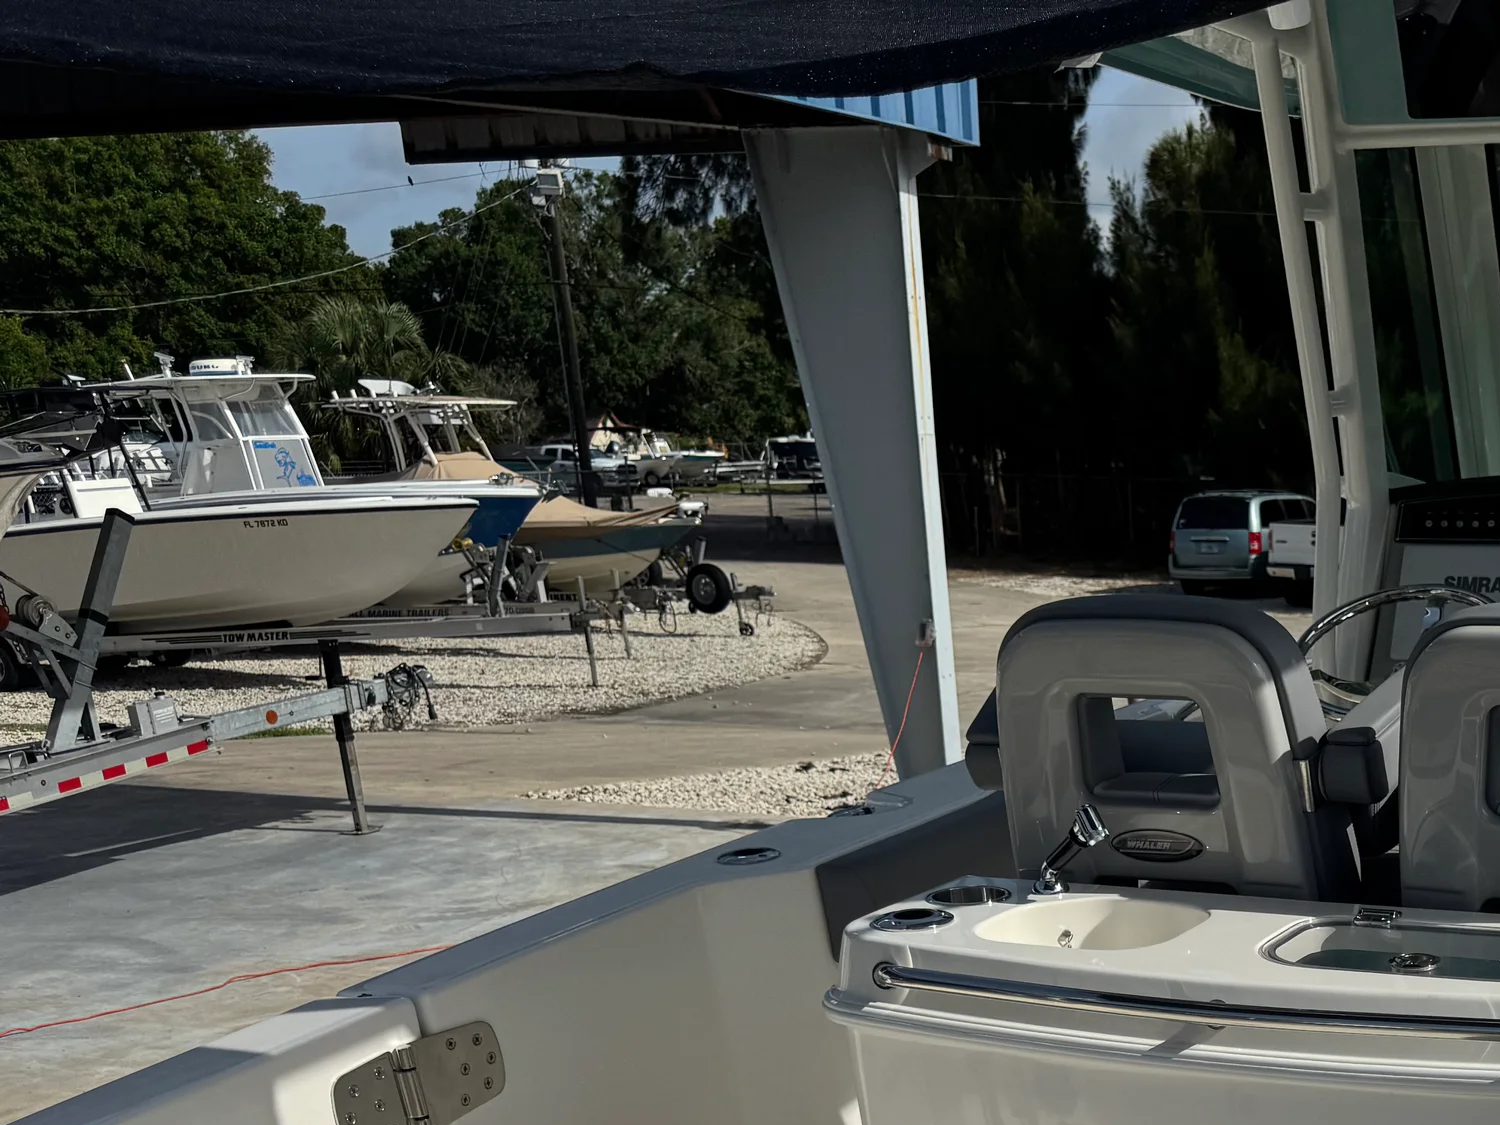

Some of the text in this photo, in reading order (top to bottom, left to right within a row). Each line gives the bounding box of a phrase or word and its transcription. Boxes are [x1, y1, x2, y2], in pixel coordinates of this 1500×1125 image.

[243, 520, 254, 528] FL
[254, 519, 276, 528] 7872
[367, 609, 402, 617] MARINE
[407, 608, 450, 617] TRAILERS
[222, 631, 289, 643] TOW MASTER
[1127, 840, 1171, 850] WHALER
